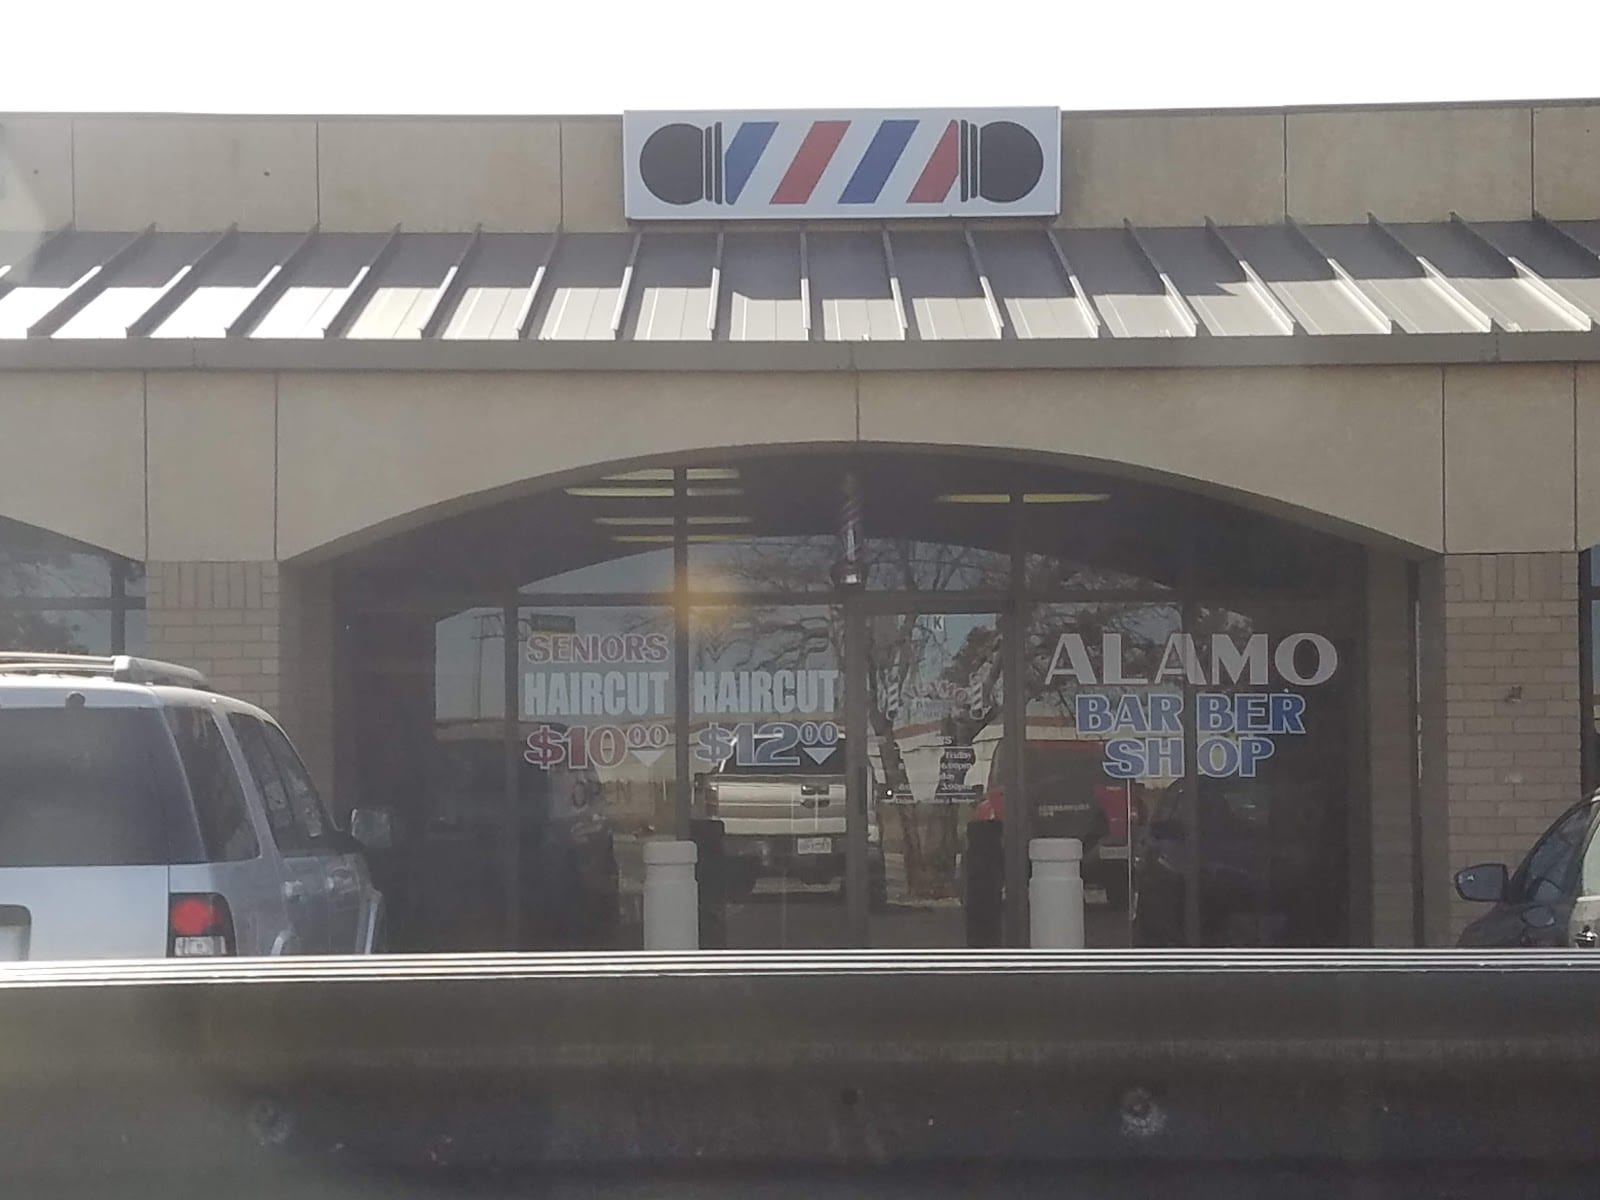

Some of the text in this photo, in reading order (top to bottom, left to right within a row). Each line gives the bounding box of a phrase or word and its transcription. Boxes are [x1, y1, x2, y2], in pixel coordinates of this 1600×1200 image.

[526, 633, 669, 664] SENIORS
[1044, 632, 1338, 686] ALAMO
[524, 670, 669, 716] HAIRCUT
[694, 669, 838, 714] HAIRCUT
